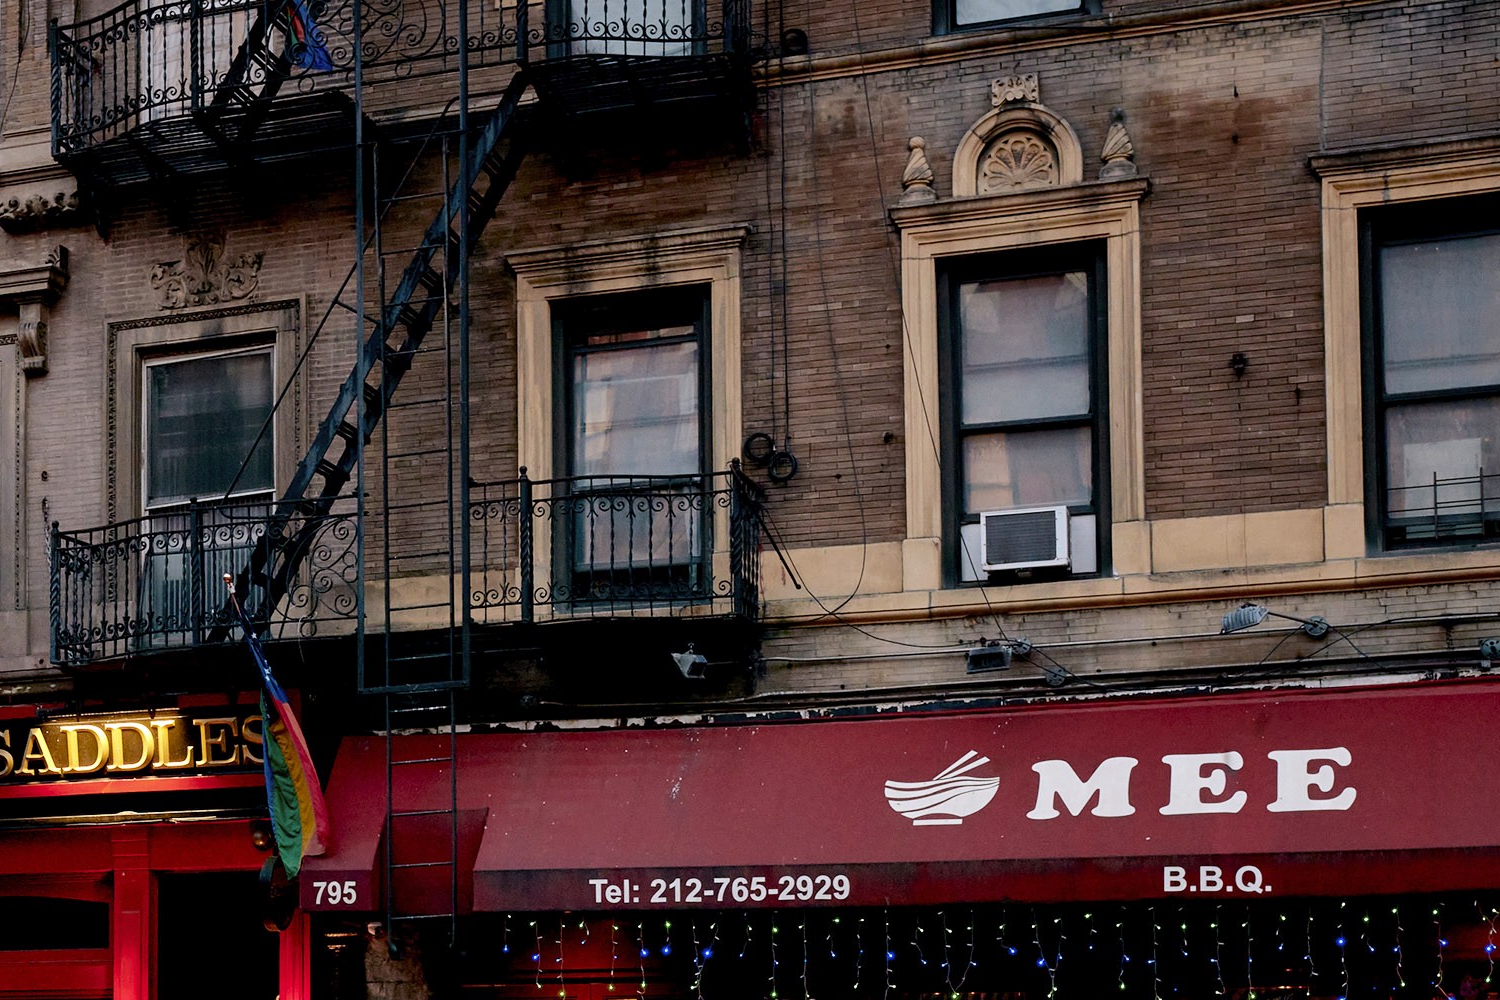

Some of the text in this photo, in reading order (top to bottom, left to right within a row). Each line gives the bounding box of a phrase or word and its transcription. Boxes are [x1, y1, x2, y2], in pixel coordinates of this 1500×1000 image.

[1026, 747, 1357, 820] MEE
[312, 880, 358, 905] 795
[589, 875, 850, 903] Tel: 212-765-2929
[1163, 865, 1272, 894] B.B.Q.
